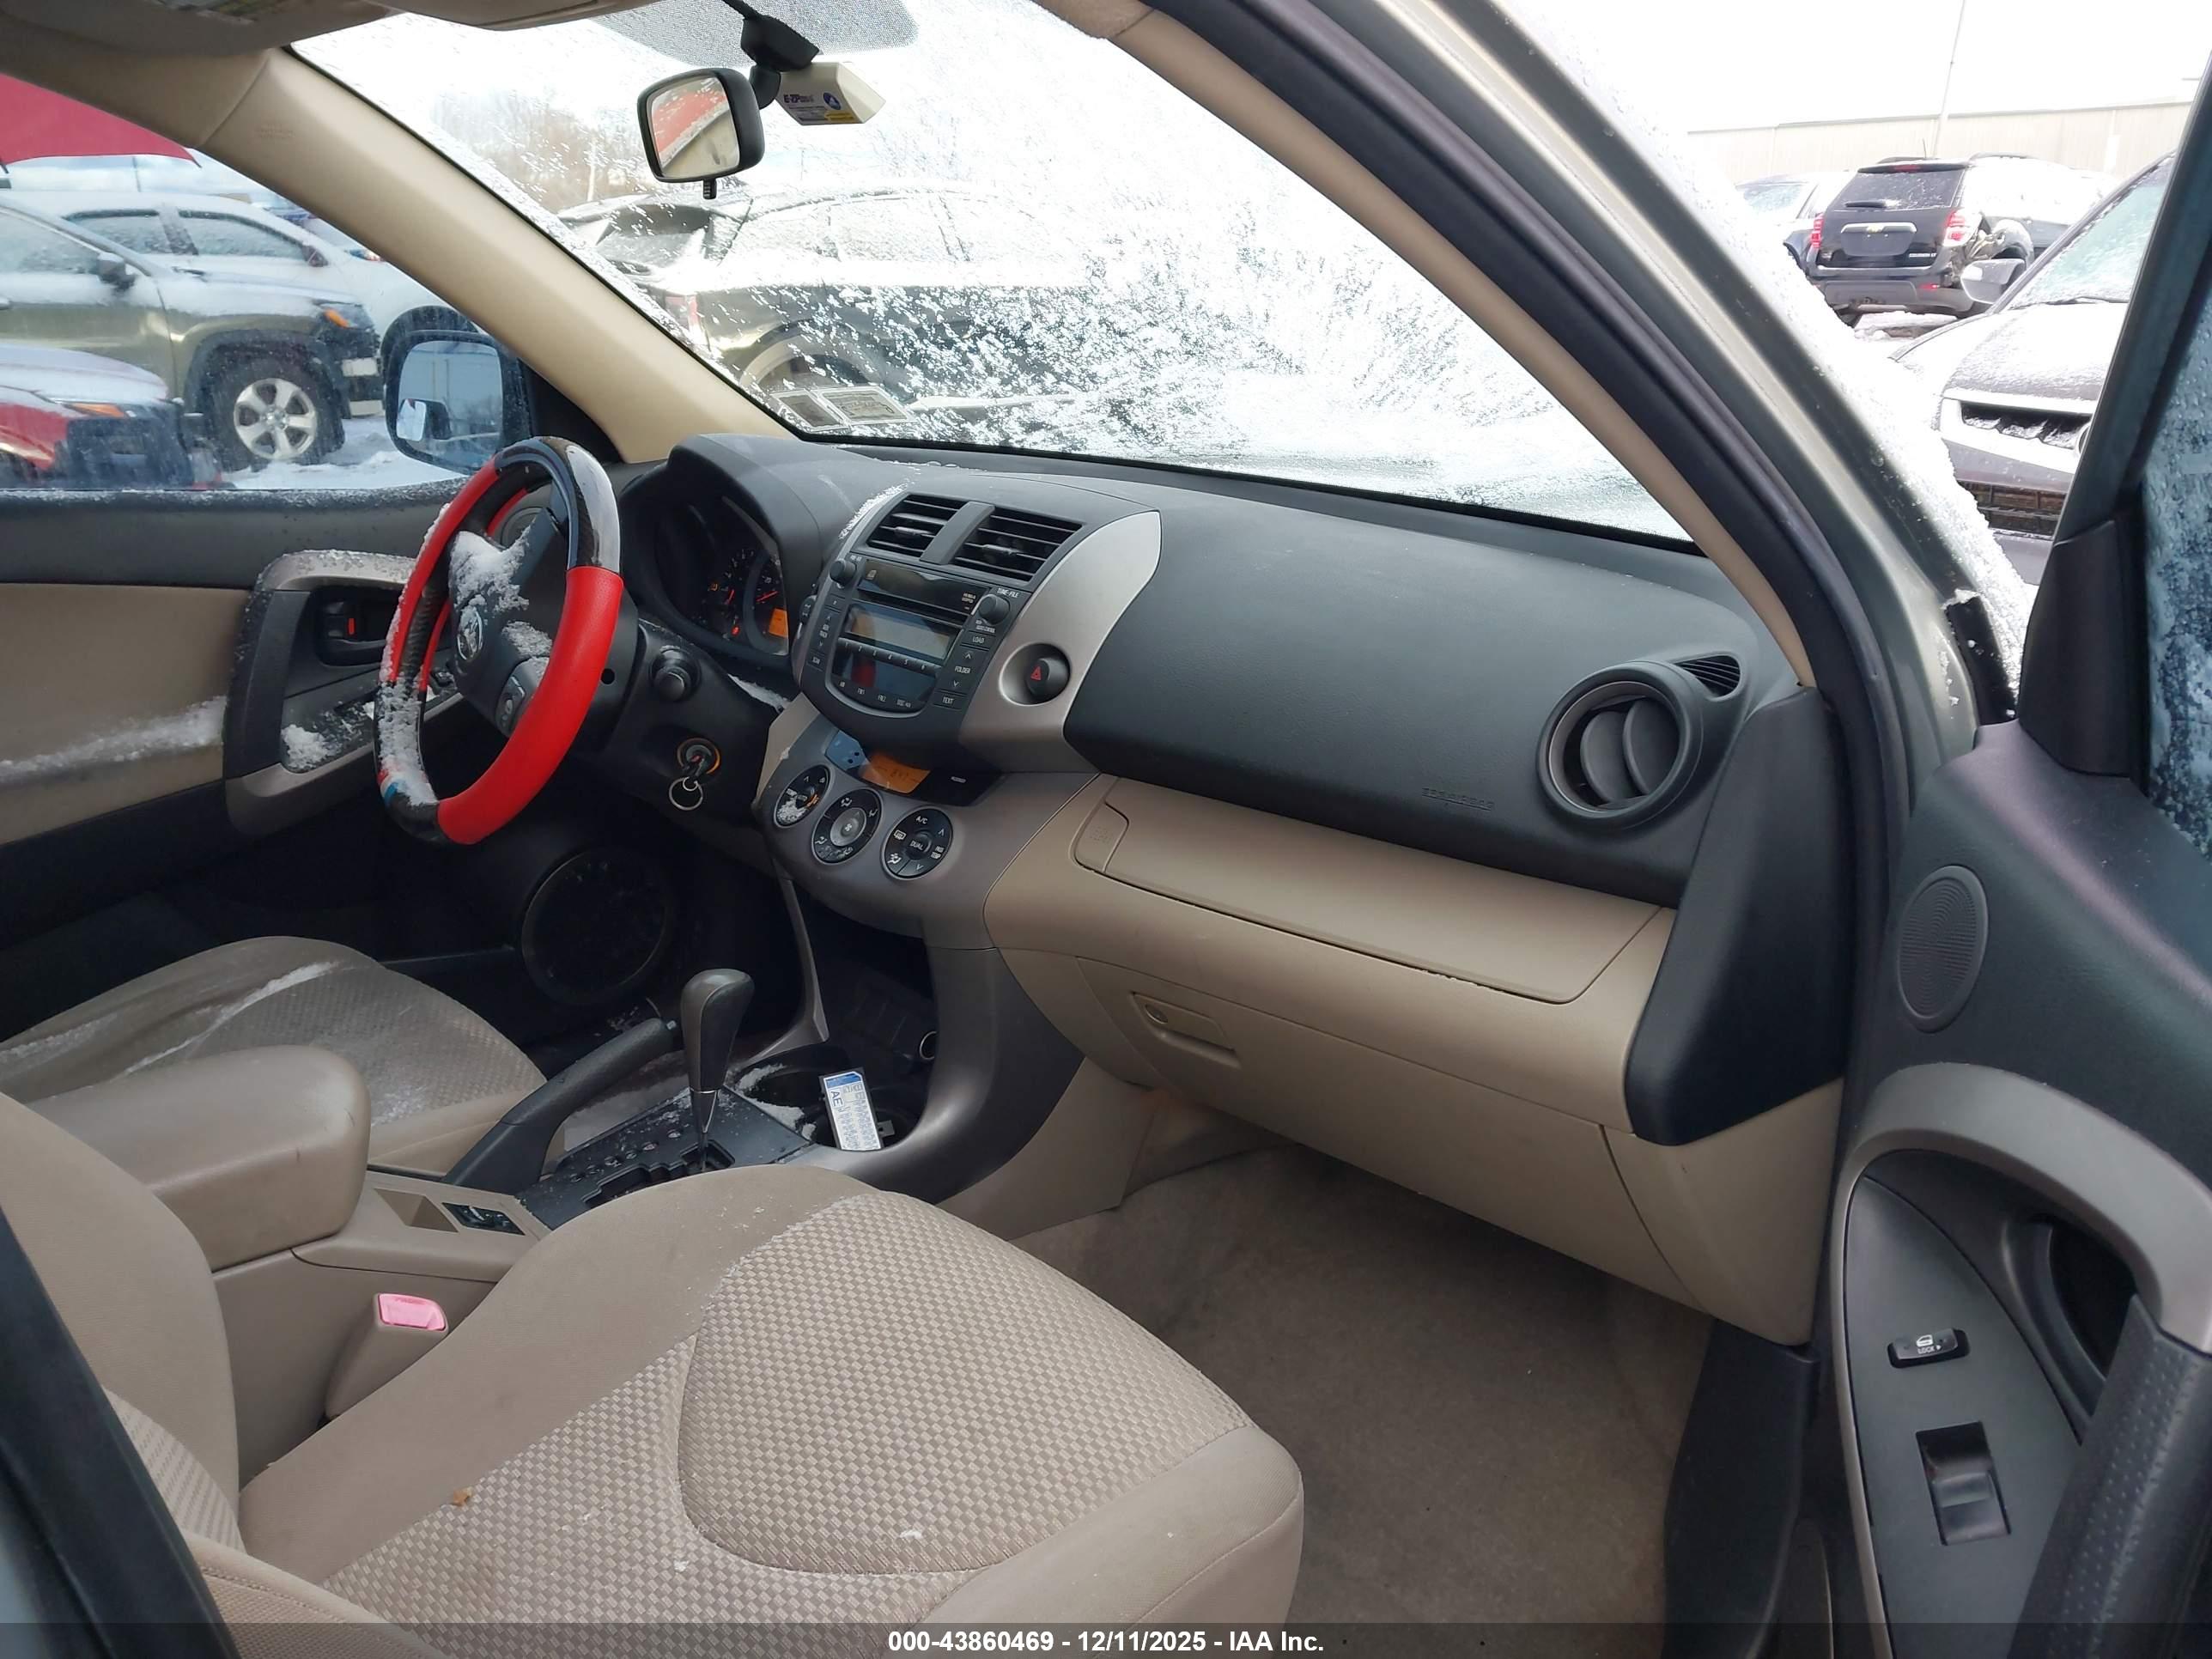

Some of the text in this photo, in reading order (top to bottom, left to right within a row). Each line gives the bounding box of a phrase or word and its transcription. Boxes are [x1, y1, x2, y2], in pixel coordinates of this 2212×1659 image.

[954, 665, 971, 674] FOLDER
[915, 815, 927, 824] A/C
[909, 840, 924, 851] DUAL
[1917, 1345, 1935, 1354] LOCK
